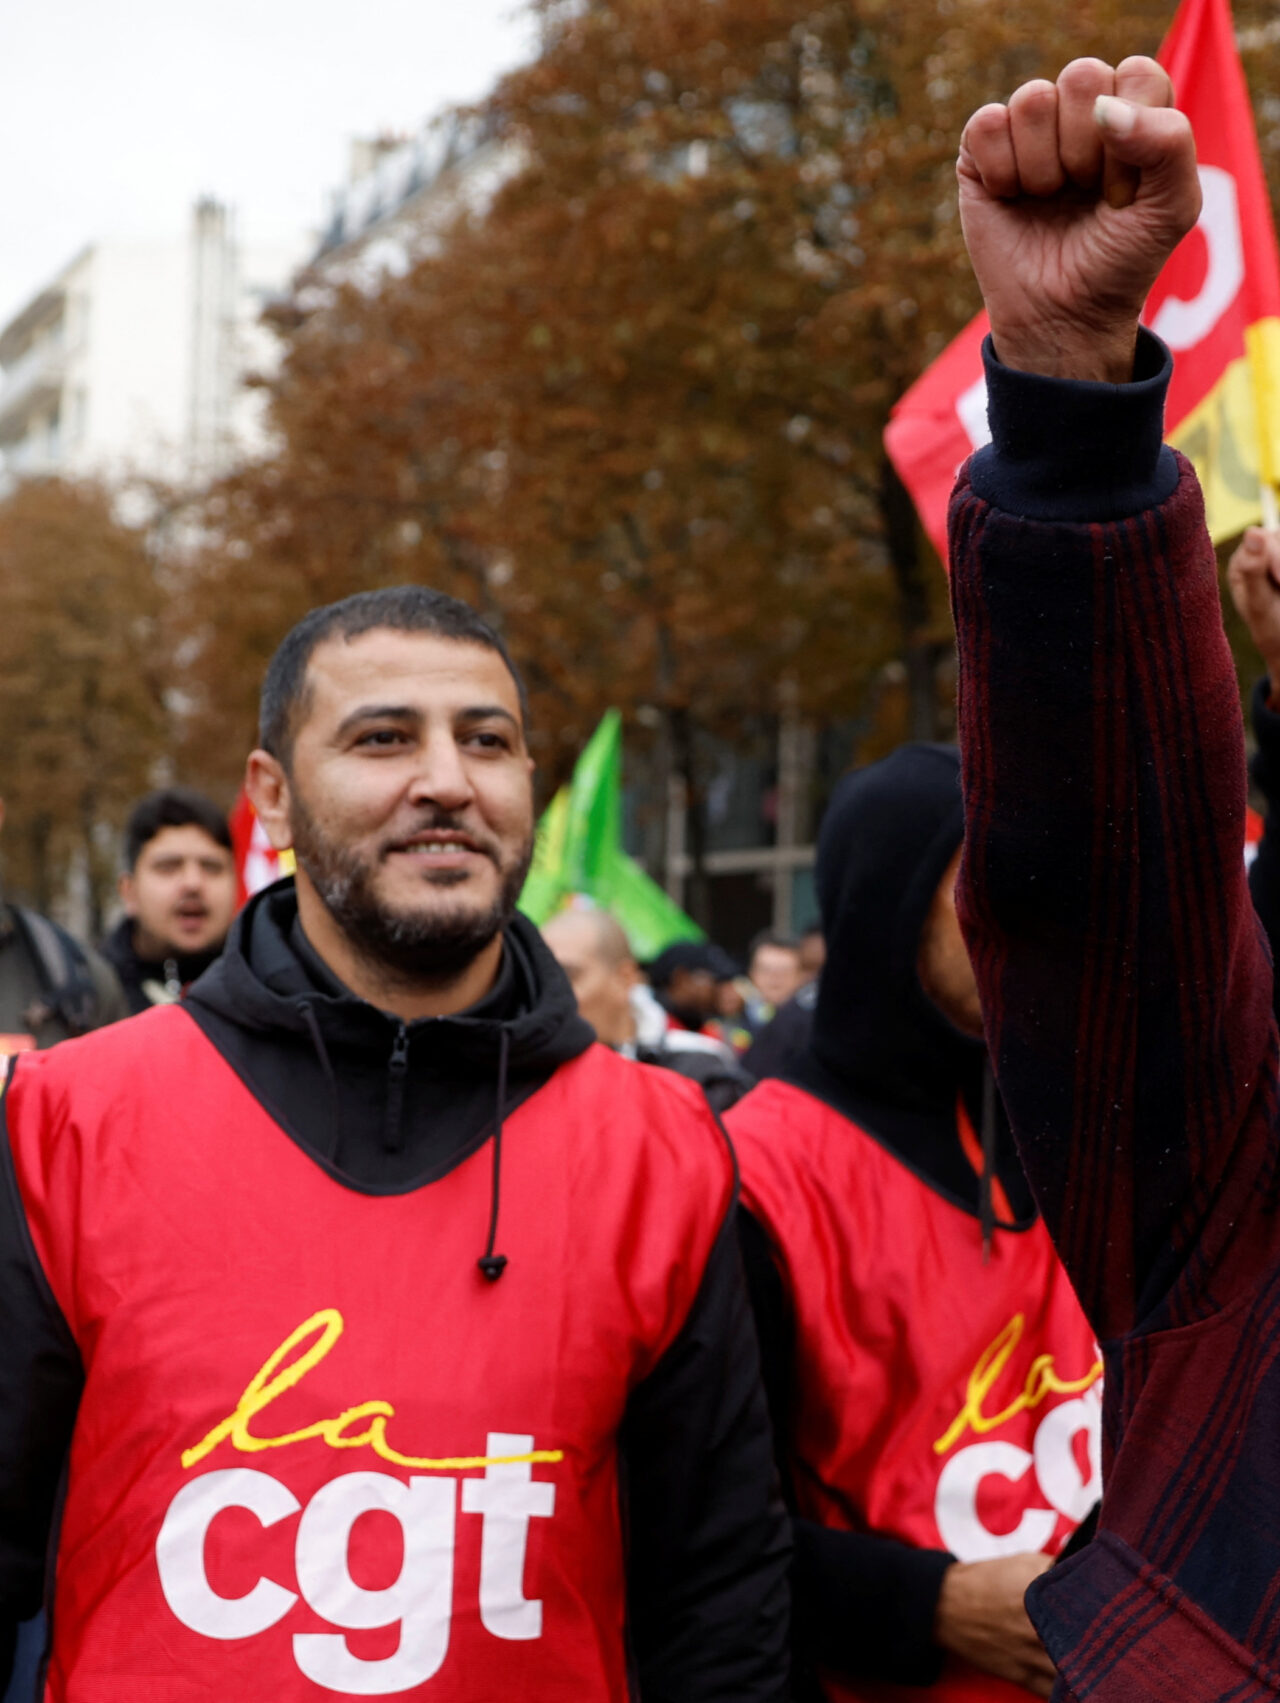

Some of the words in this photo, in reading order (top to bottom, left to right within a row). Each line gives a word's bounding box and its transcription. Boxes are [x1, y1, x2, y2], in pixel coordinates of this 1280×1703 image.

[181, 1308, 563, 1469] la
[933, 1312, 1104, 1454] la
[934, 1340, 1104, 1564] cg
[155, 1432, 556, 1695] cgt
